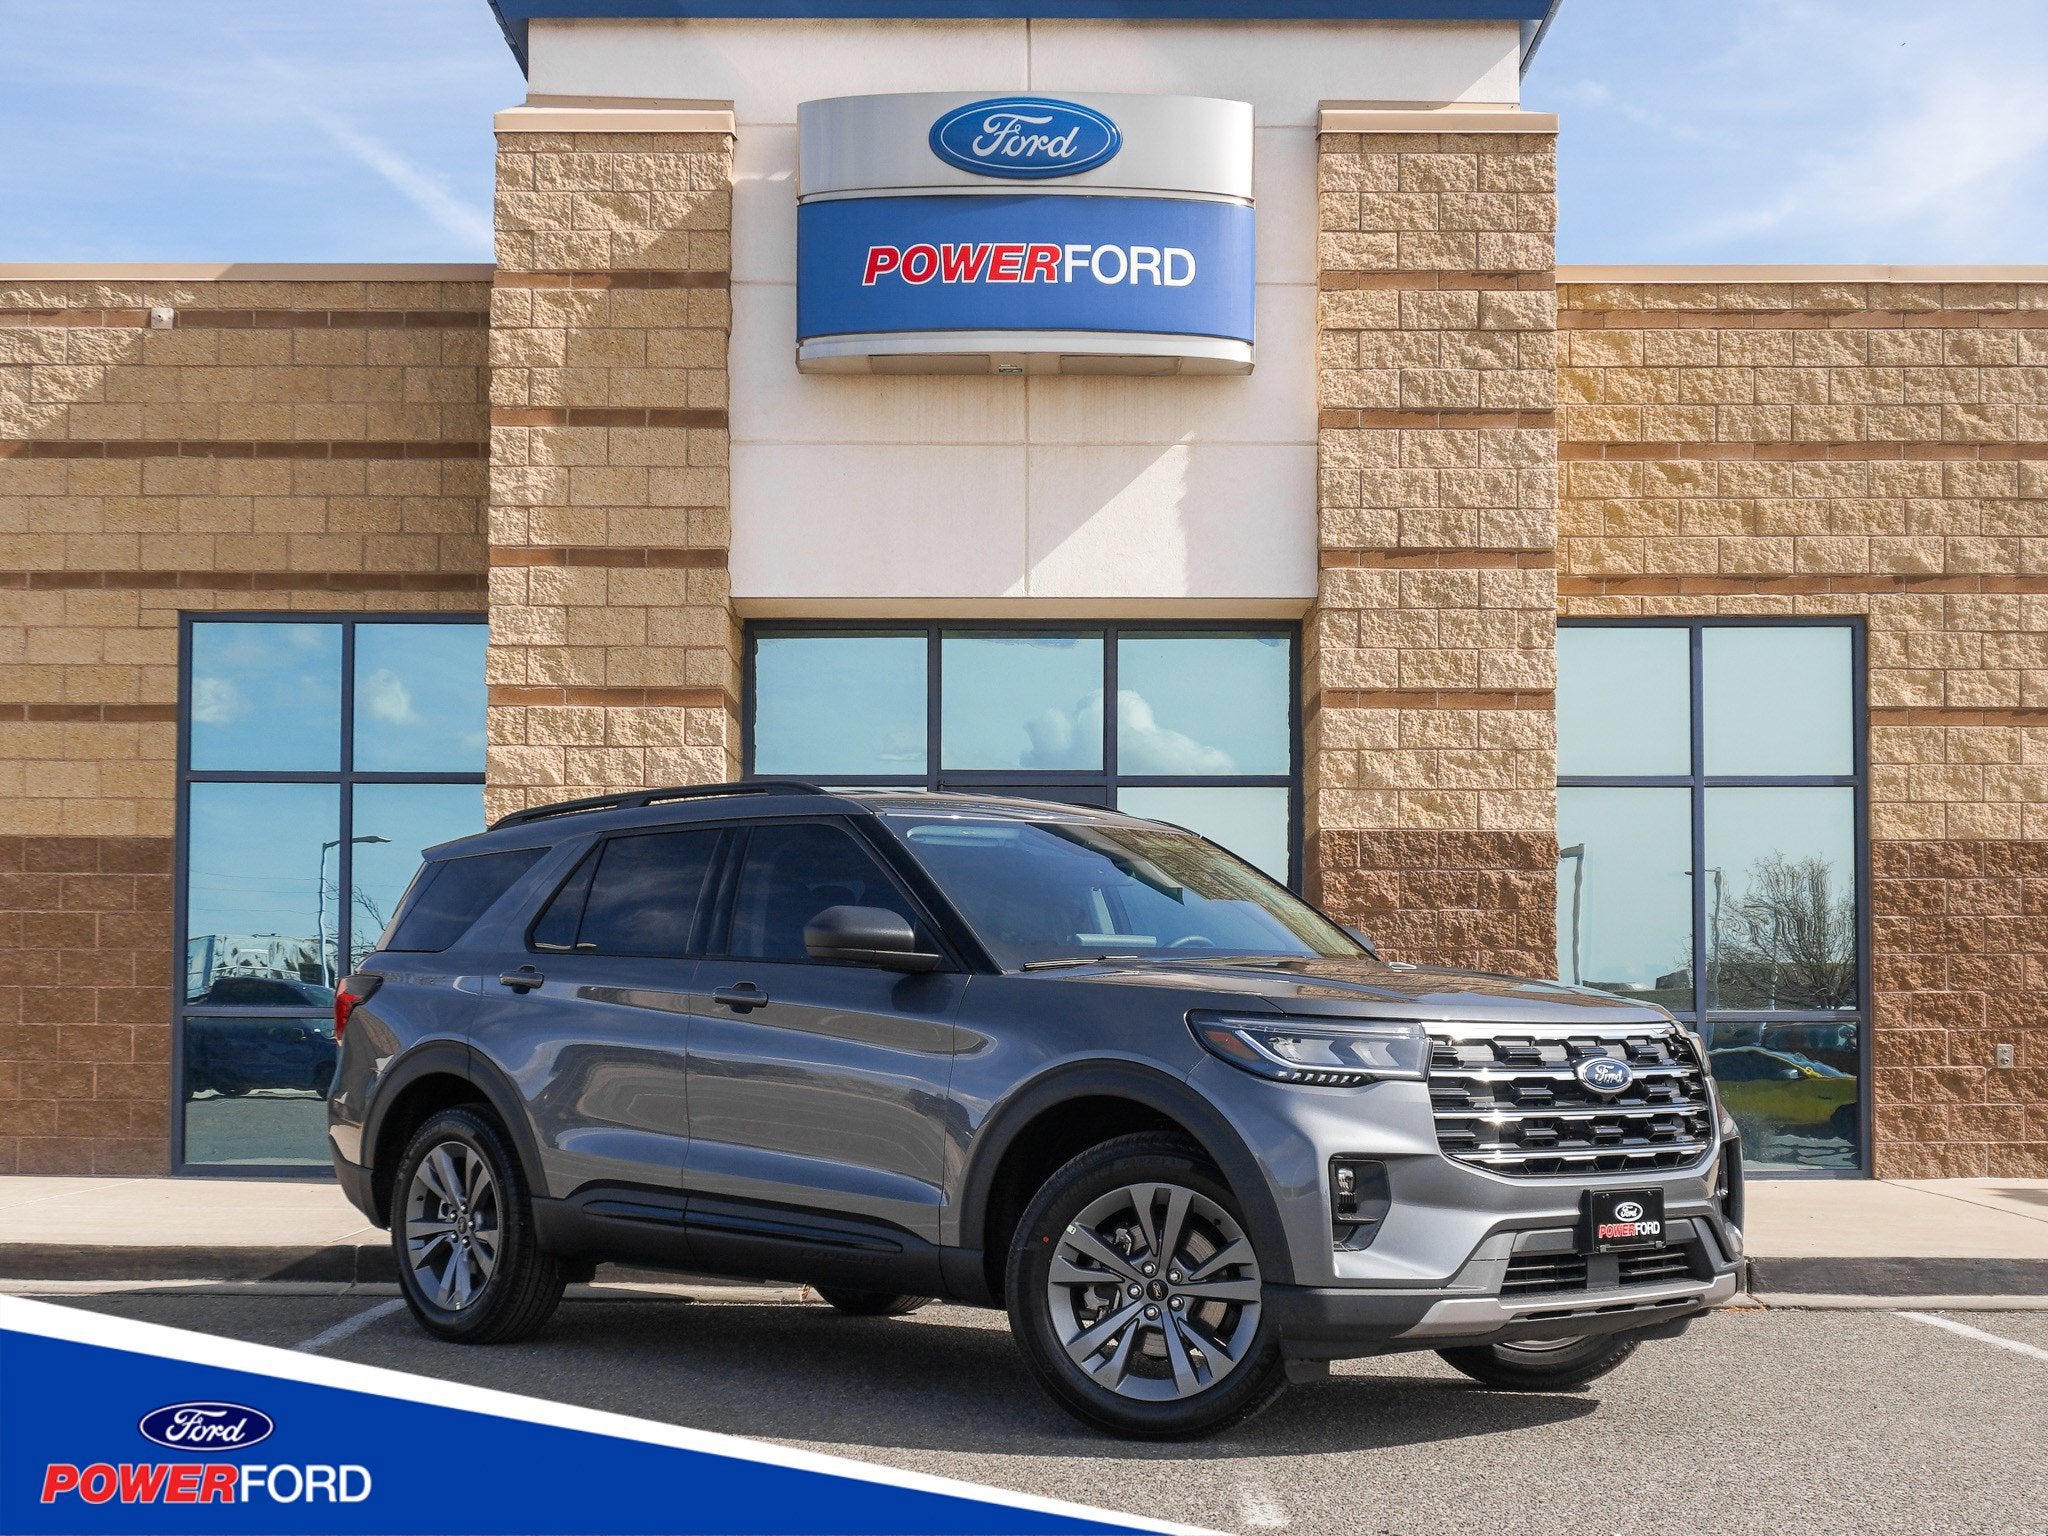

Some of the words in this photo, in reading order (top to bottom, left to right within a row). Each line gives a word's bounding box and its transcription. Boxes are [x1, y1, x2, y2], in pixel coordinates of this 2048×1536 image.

[972, 113, 1079, 159] Ford
[862, 243, 1196, 286] POWERFORD
[1594, 1064, 1624, 1084] Ford
[1598, 1221, 1661, 1239] POWERFORD
